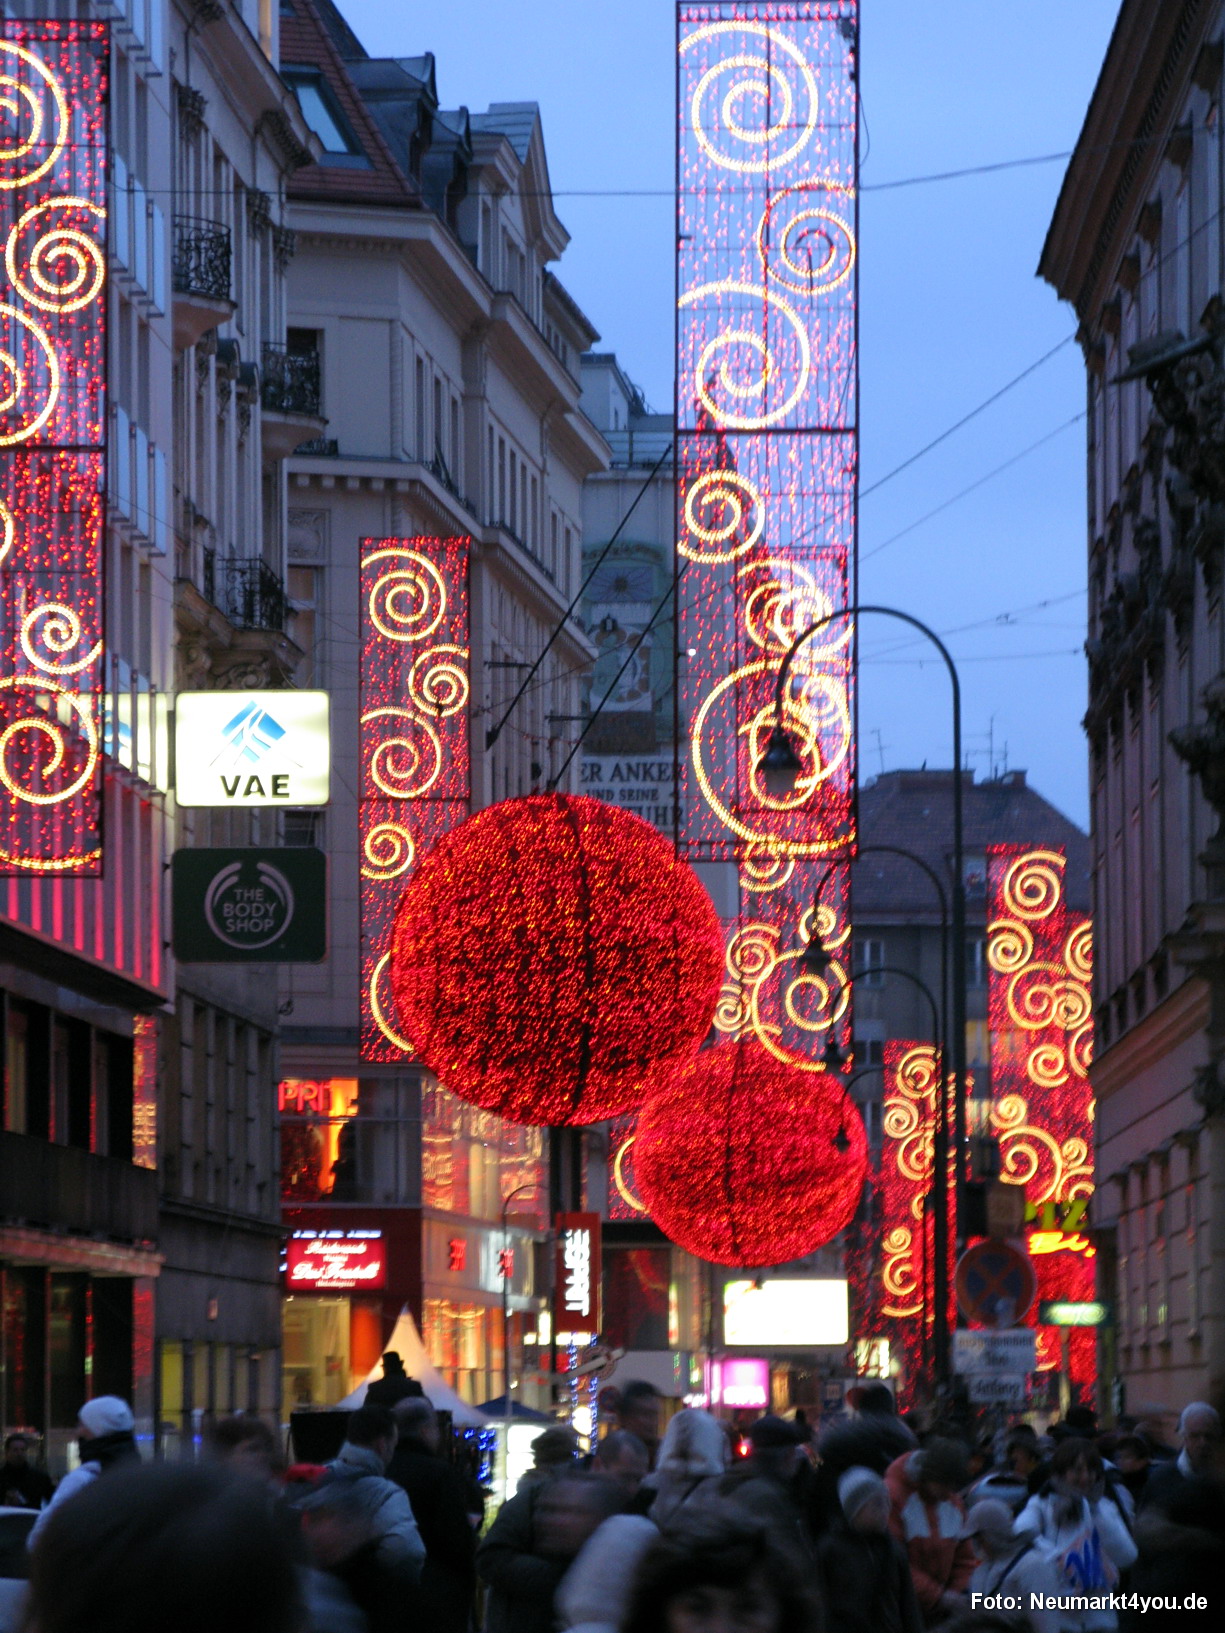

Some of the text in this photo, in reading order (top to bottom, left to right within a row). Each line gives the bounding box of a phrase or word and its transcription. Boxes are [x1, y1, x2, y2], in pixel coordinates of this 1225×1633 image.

[609, 762, 685, 782] ANKER
[220, 774, 290, 798] VAE
[619, 789, 657, 801] SEINE
[234, 888, 264, 901] THE
[223, 902, 277, 917] BODY
[225, 918, 274, 932] SHOP
